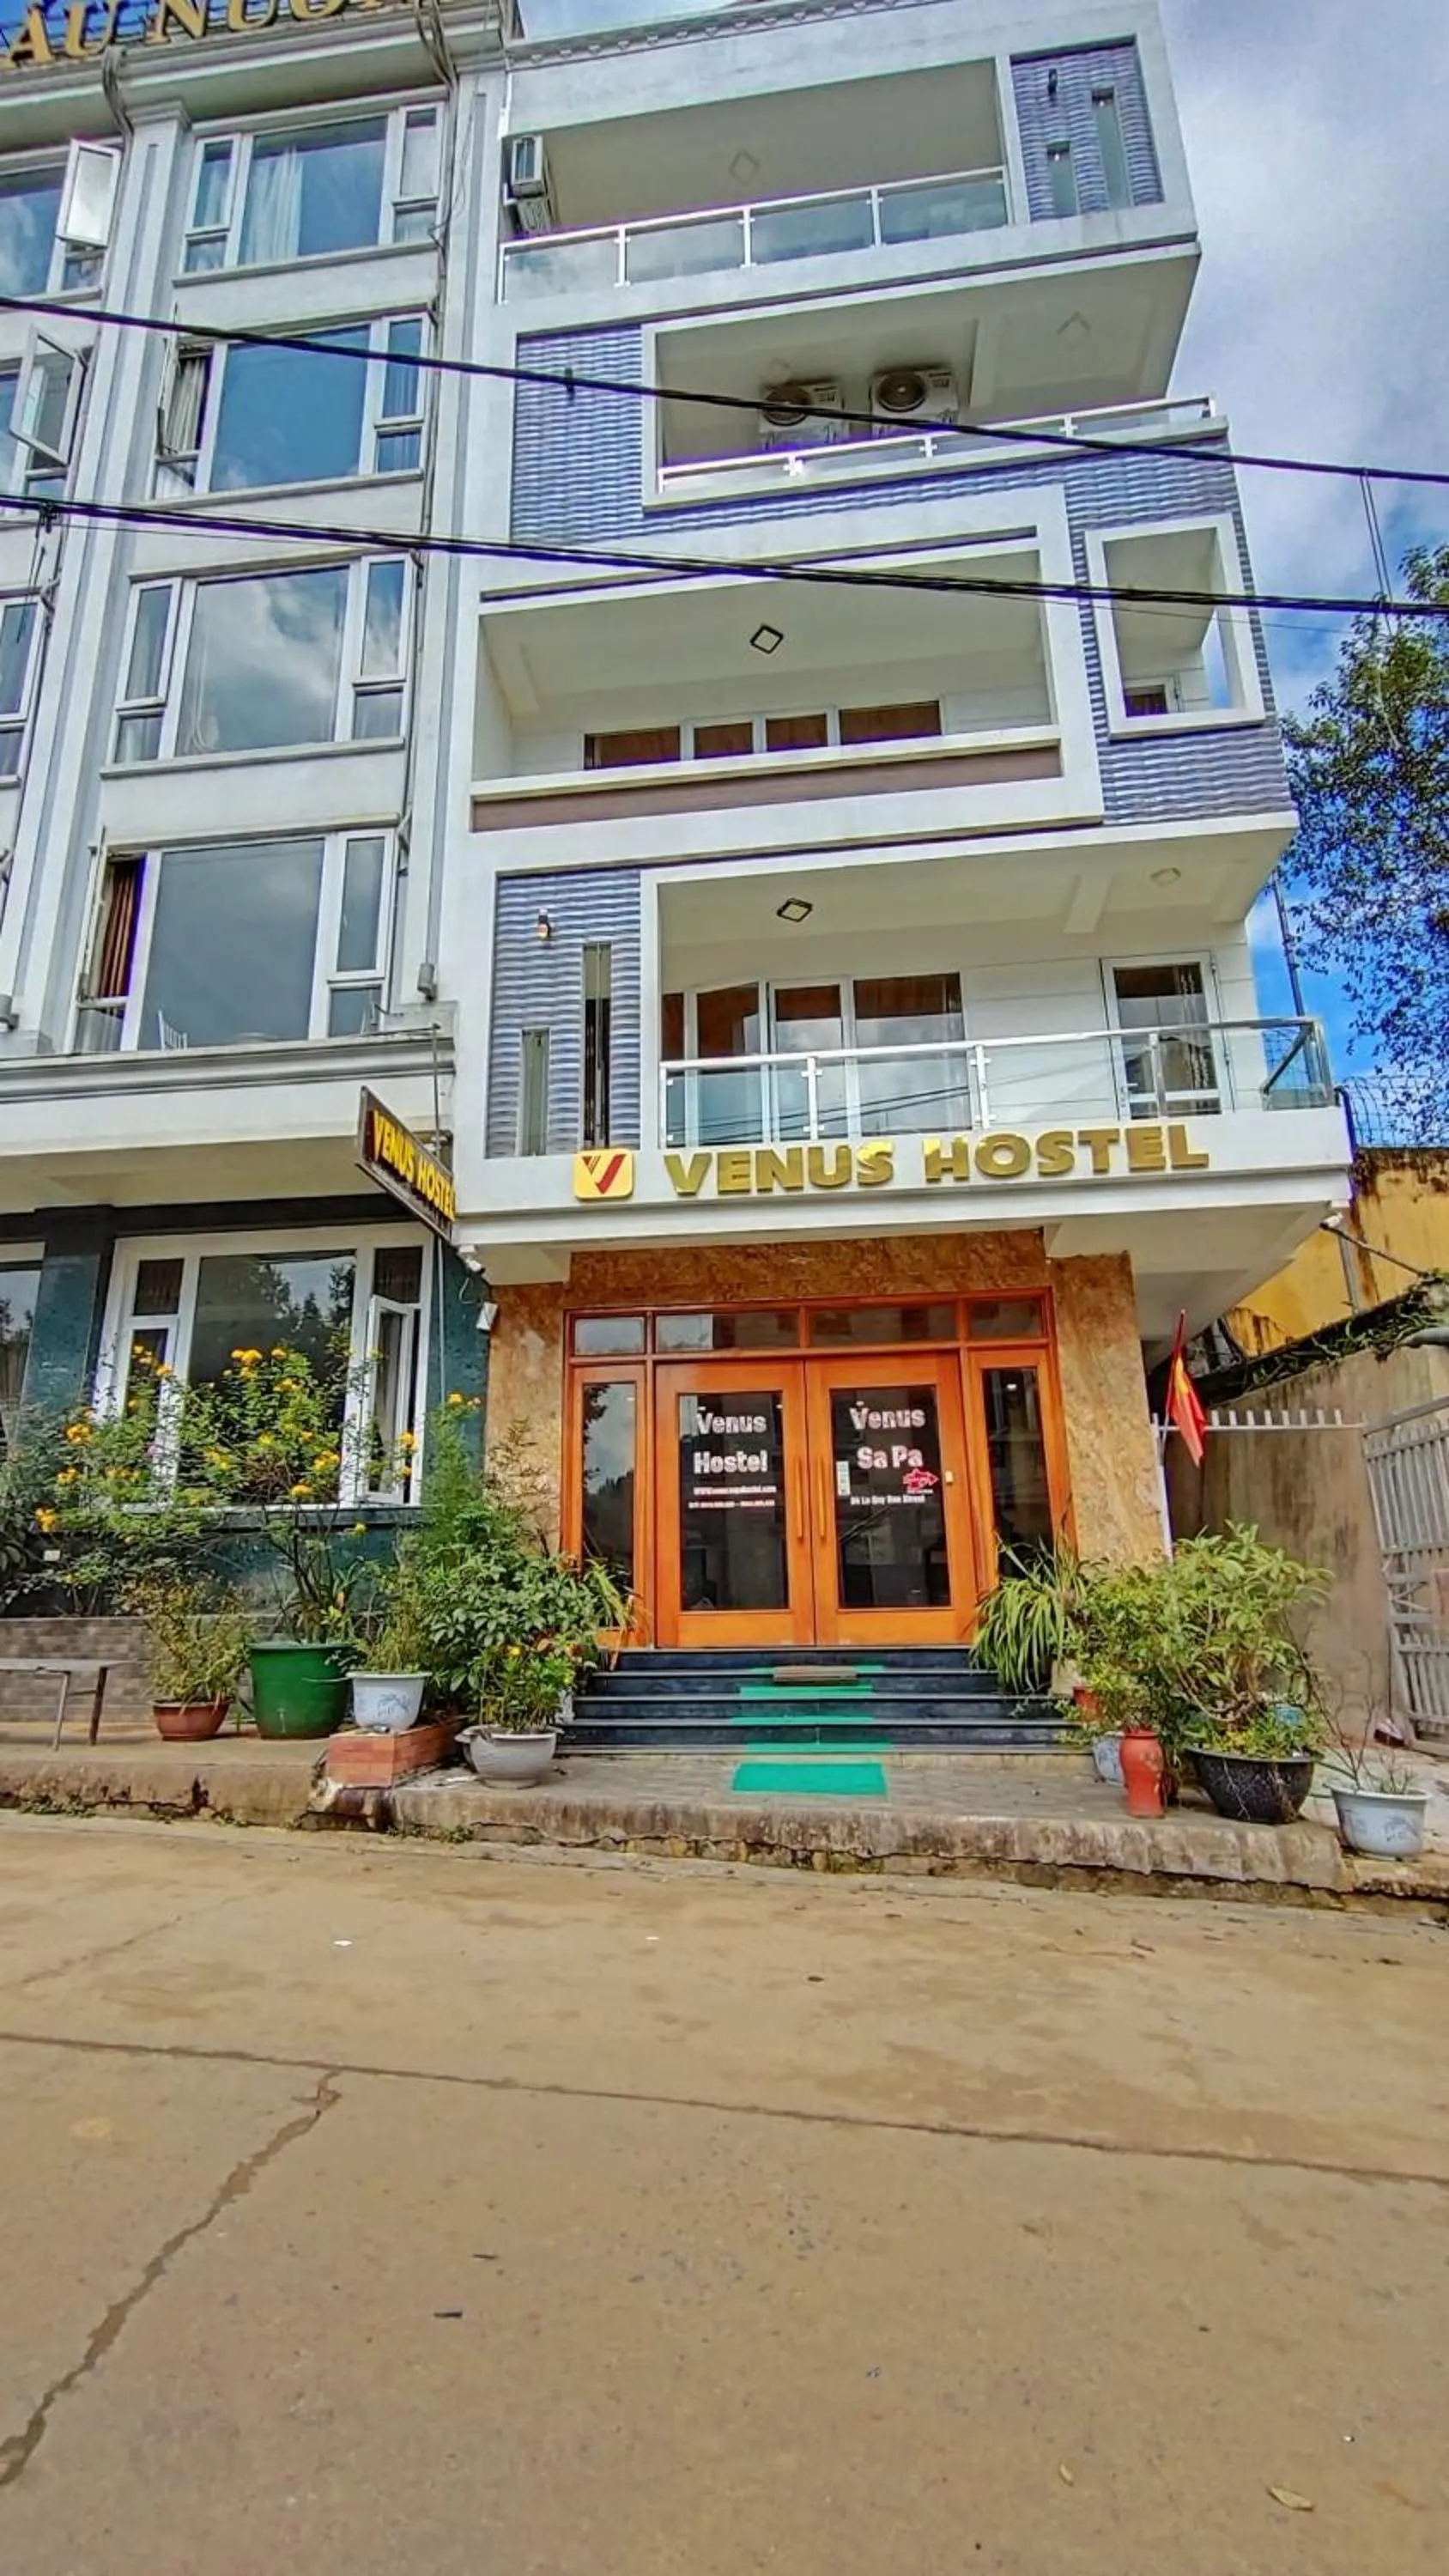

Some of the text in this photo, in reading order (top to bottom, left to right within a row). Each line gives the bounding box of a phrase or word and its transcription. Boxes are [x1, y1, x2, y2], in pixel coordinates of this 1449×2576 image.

[373, 1109, 458, 1222] VENUS HOSTEL
[664, 1124, 1210, 1196] VENUS HOSTEL
[696, 1413, 767, 1435] Venus
[849, 1407, 925, 1430] Venus
[694, 1449, 768, 1474] Hostel
[857, 1445, 924, 1469] Sa Pa
